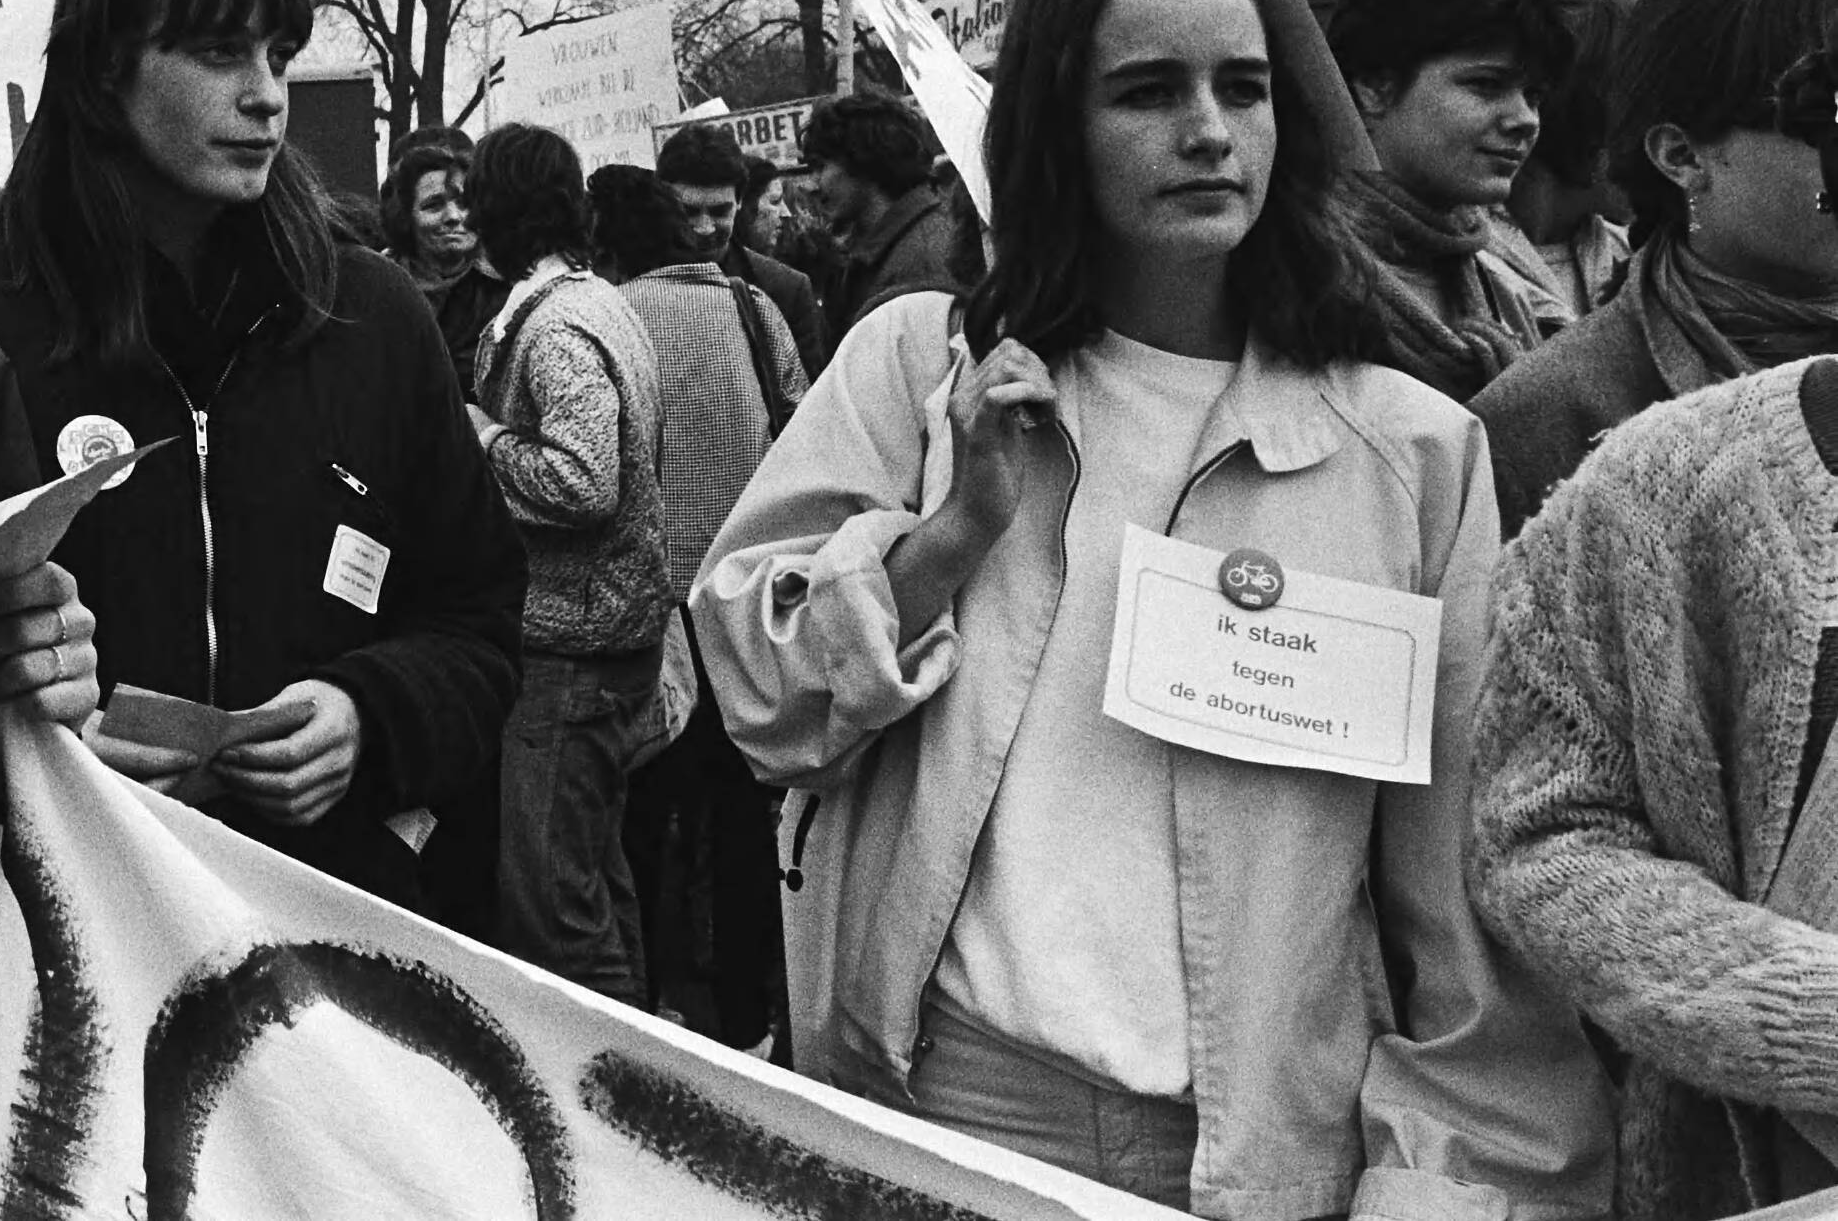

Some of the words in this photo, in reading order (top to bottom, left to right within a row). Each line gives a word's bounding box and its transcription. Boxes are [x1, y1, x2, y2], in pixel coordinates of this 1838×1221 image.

[1217, 614, 1238, 636] ik
[1248, 625, 1319, 655] staak
[1232, 660, 1296, 690] tegen
[1169, 681, 1198, 702] de
[1206, 693, 1334, 735] abortuswet
